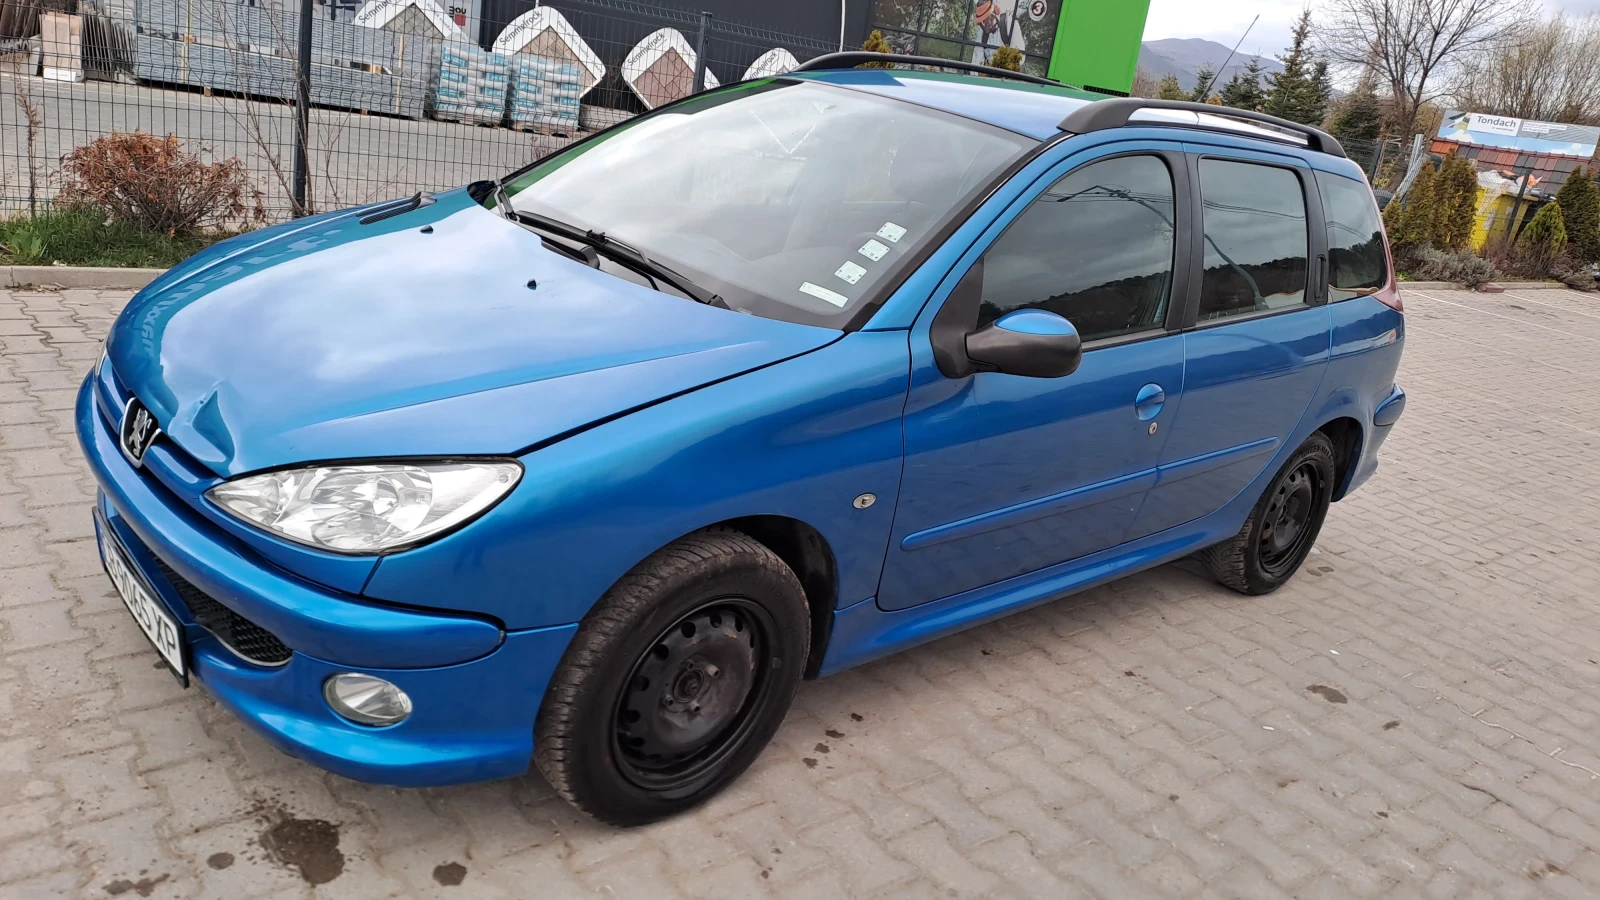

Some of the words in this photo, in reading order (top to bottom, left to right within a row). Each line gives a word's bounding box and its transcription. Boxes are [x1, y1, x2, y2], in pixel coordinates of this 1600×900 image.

[499, 10, 542, 46] Semmelrock
[627, 32, 665, 66] Semmelrock
[1477, 115, 1517, 128] Tondach
